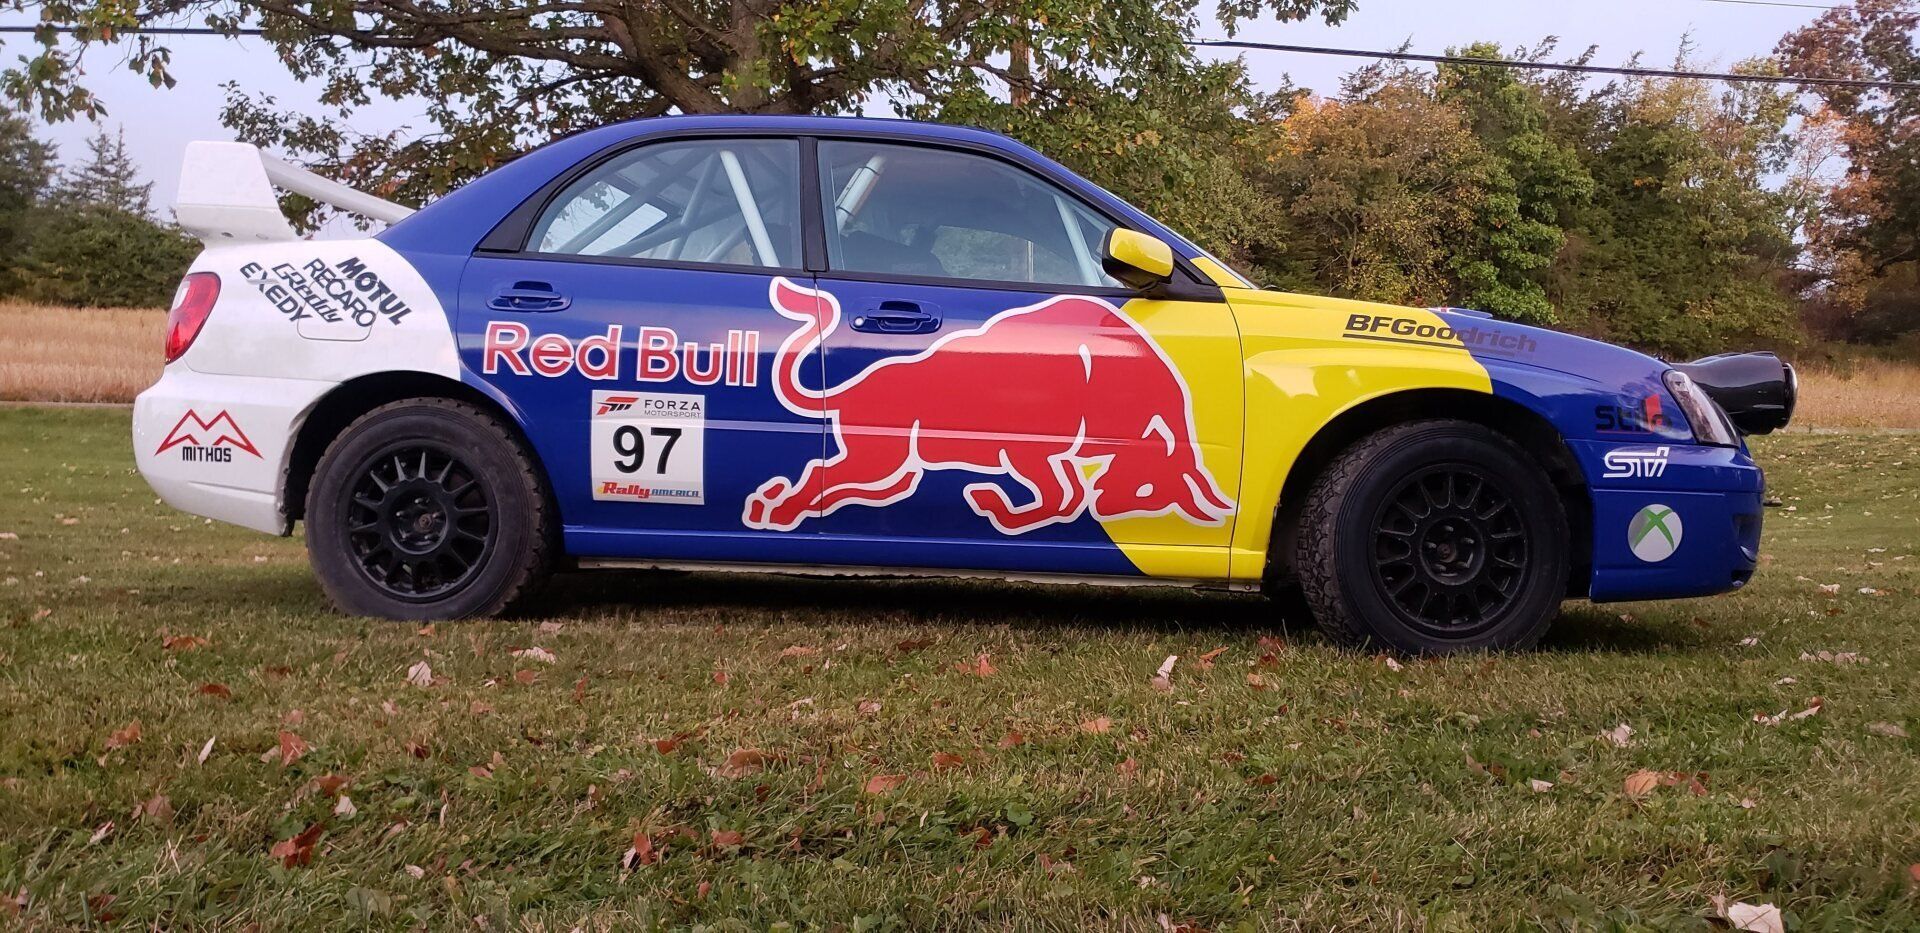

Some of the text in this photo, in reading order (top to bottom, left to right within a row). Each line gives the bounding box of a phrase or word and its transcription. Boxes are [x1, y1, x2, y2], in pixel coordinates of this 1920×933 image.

[239, 261, 313, 323] EXEDY
[302, 257, 377, 328] RECARO
[335, 256, 412, 326] MOTUL
[482, 320, 760, 388] Red Bull
[1345, 313, 1537, 353] BFGoodrich
[644, 399, 701, 411] FORZA
[644, 410, 702, 419] MOTORSPORT
[182, 446, 232, 463] MITHOS
[612, 425, 682, 475] 97
[602, 481, 699, 499] Rally AMERICA
